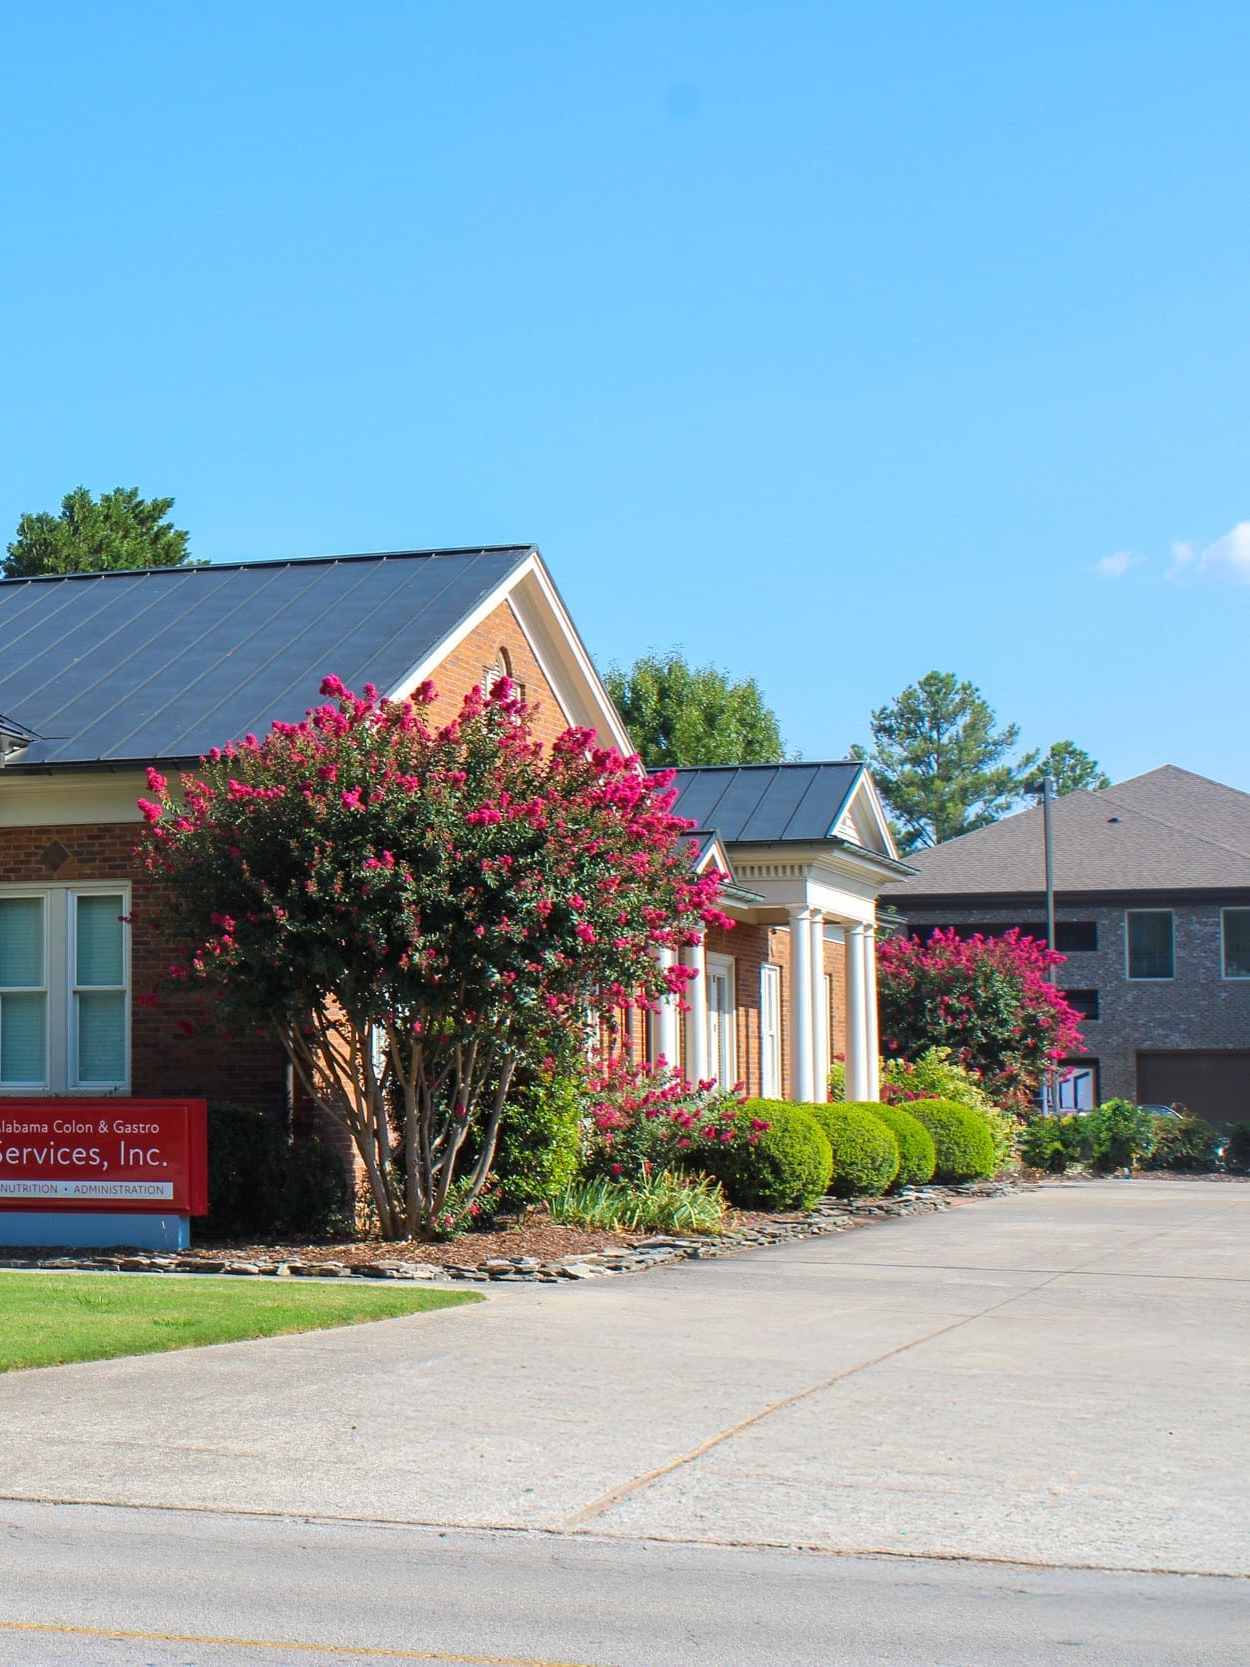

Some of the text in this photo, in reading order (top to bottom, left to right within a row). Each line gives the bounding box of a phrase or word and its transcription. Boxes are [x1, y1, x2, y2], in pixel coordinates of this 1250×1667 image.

[53, 1120, 93, 1134] Colon
[98, 1120, 109, 1133] &
[113, 1120, 159, 1134] Gastro
[120, 1140, 168, 1167] Inc.
[0, 1184, 58, 1194] NUTRITION
[74, 1185, 164, 1195] ADMINISTRATION
